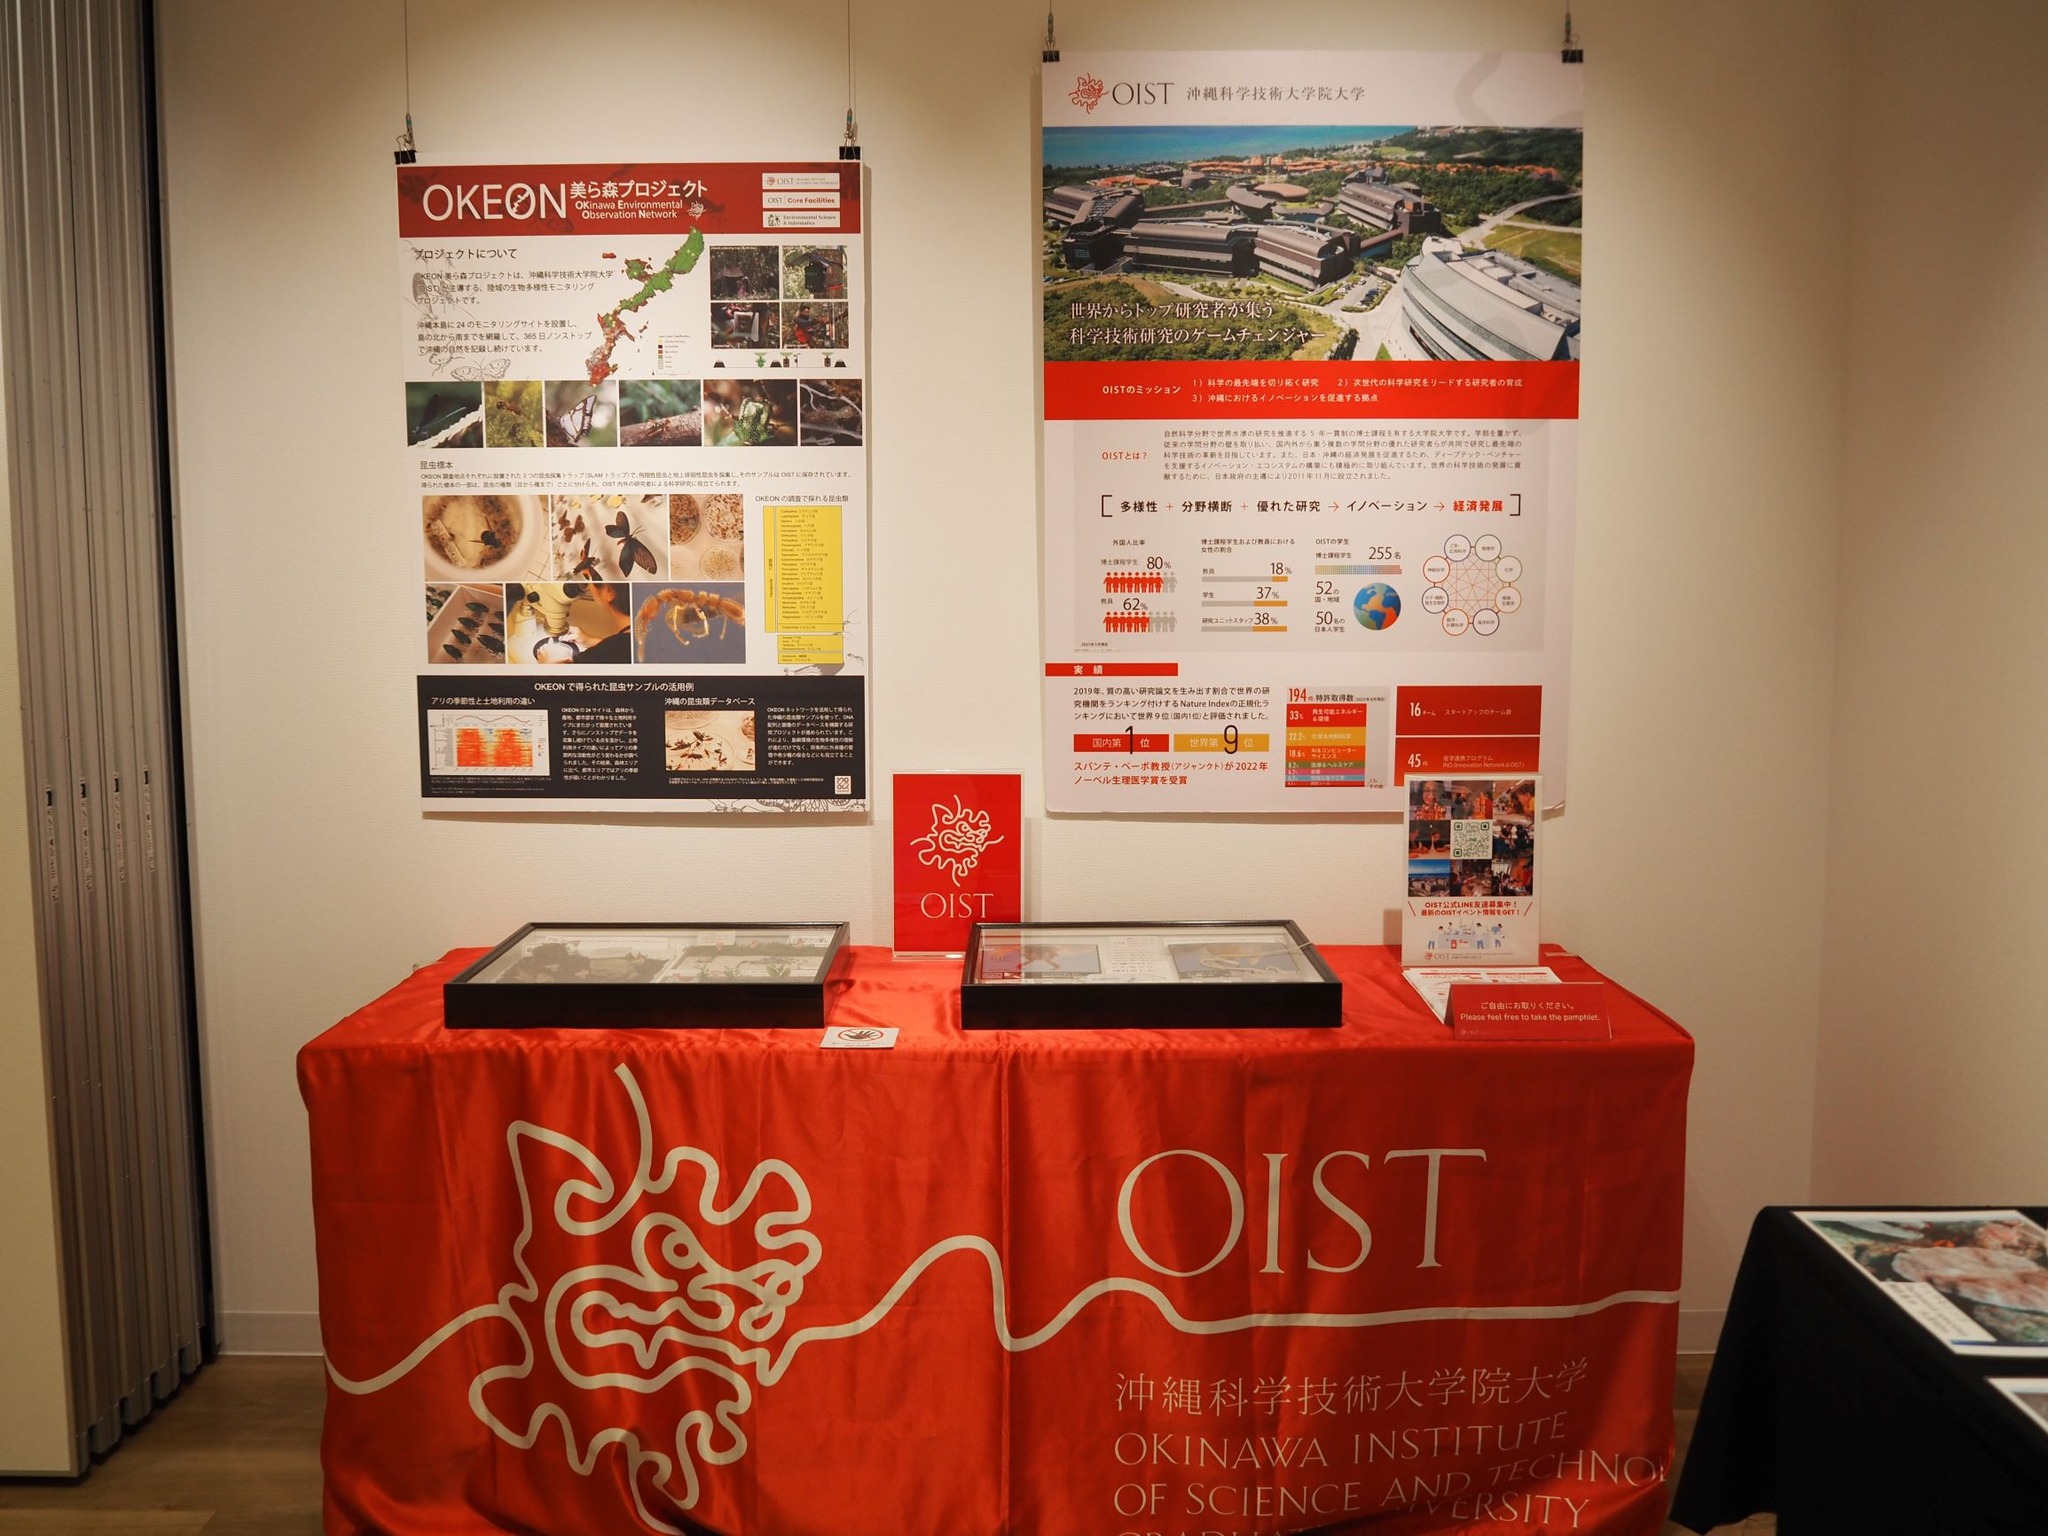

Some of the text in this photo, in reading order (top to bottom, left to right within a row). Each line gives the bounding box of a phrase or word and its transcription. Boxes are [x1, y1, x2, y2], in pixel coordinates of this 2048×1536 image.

[1112, 82, 1365, 105] OIST 沖縄科学技術大学院大学
[423, 180, 707, 221] OKEON 美ら森プロジェクト
[575, 200, 683, 210] OKinawa Environmental
[582, 210, 678, 220] Observation Network
[414, 248, 517, 261] プロジェクトについて
[1070, 302, 1273, 319] 世界からトップ研究者が集う
[1069, 327, 1326, 344] 科学技術研究のゲームチェンジャー
[1102, 385, 1181, 394] OISTのミッション
[420, 461, 454, 470] 昆虫標本
[1120, 500, 1158, 513] 多様性
[1182, 500, 1232, 513] 分野横断
[1257, 500, 1321, 513] 優れた研究
[1347, 500, 1427, 512] イノベーション
[1453, 500, 1504, 513] 経済発展
[534, 682, 694, 692] OKEON で得られた昆虫サンプルの活用例
[664, 697, 756, 706] 沖縄の昆虫類データベース
[1073, 775, 1188, 785] ノーベル生理医学賞を受賞
[921, 893, 994, 919] OIST
[1480, 1002, 1575, 1010] ご自由にお取りください。
[1461, 1013, 1486, 1021] Please
[1487, 1013, 1502, 1021] feel
[1503, 1013, 1520, 1021] free
[1531, 1013, 1547, 1021] take
[1549, 1013, 1562, 1021] the
[1563, 1013, 1600, 1022] pamphlet.
[1118, 1148, 1487, 1277] OIST
[1115, 1357, 1588, 1417] 沖縄科学技術大学院大学
[1115, 1411, 1568, 1469] OKINAWA INSTITUTE
[1114, 1483, 1168, 1516] OF
[1187, 1481, 1360, 1516] SCIENCE
[1381, 1471, 1471, 1507] AND
